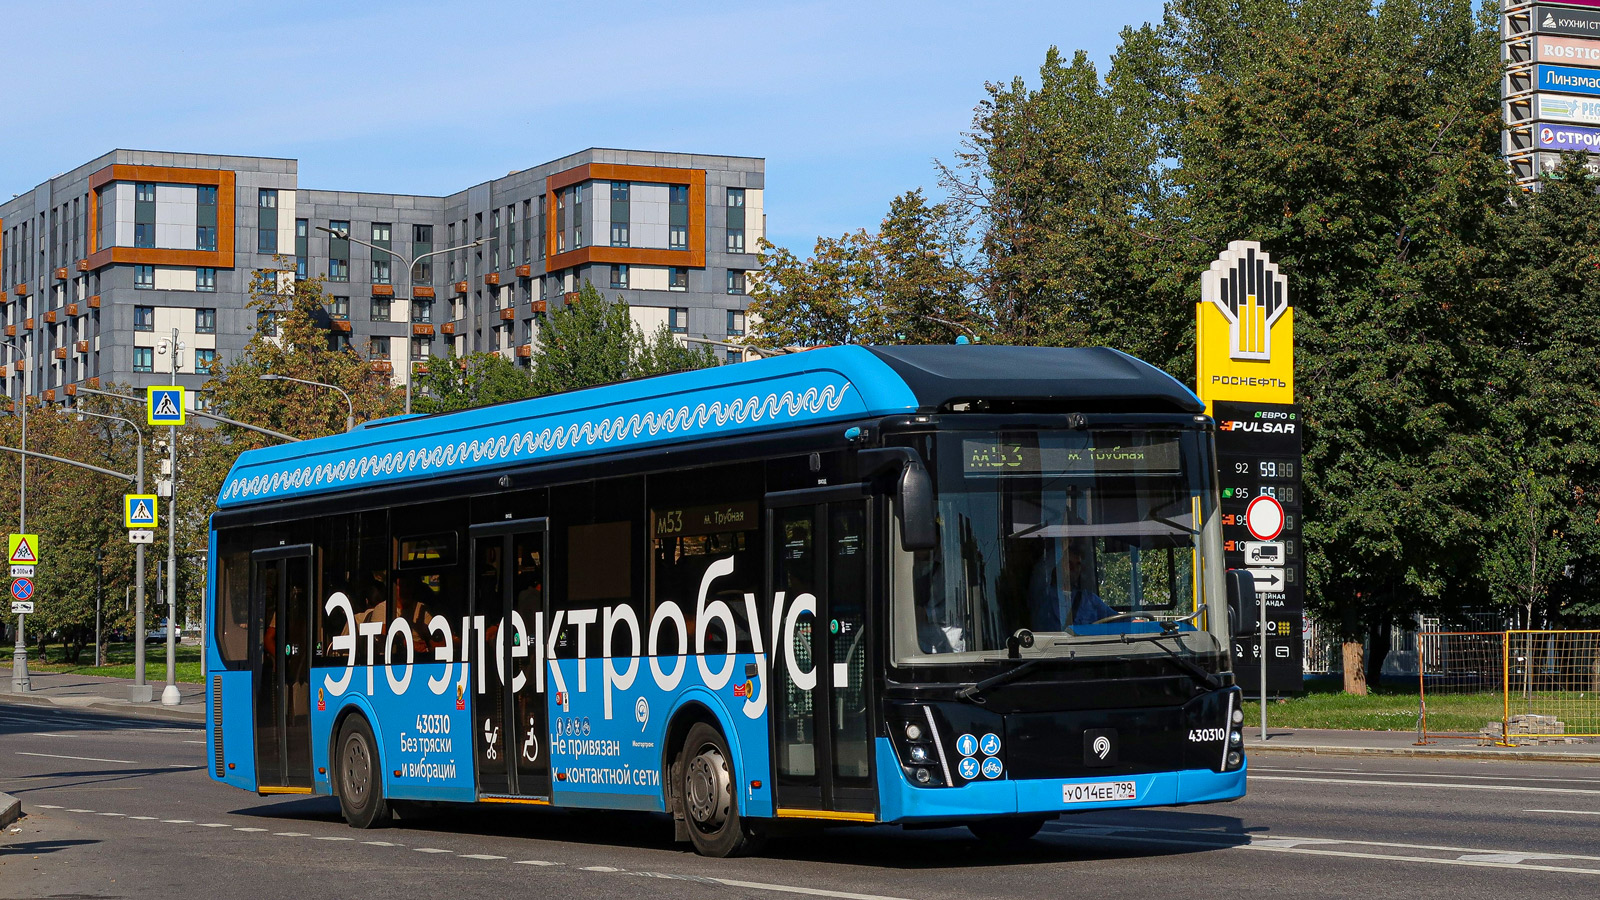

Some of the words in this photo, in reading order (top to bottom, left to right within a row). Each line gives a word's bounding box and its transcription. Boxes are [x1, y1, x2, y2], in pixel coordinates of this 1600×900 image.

[1543, 44, 1600, 60] ROSTIC
[1212, 375, 1286, 388] РОСНЕФТЬ
[1261, 411, 1288, 420] ЕВРО
[1289, 412, 1296, 420] 6
[1231, 421, 1296, 434] PULSAR
[1235, 463, 1249, 474] 92
[1235, 487, 1249, 499] 95
[714, 508, 744, 525] Трубная
[324, 592, 414, 696] Это
[427, 554, 848, 720] электробус.
[416, 714, 451, 734] 430310
[1188, 728, 1225, 742] 430310
[400, 732, 418, 752] Без
[418, 737, 452, 757] тряски
[550, 733, 566, 755] Не
[568, 739, 620, 760] привязан
[401, 763, 408, 777] и
[409, 758, 456, 783] вибраций
[566, 763, 631, 785] контактной
[632, 769, 660, 786] сети
[1115, 783, 1132, 794] 799
